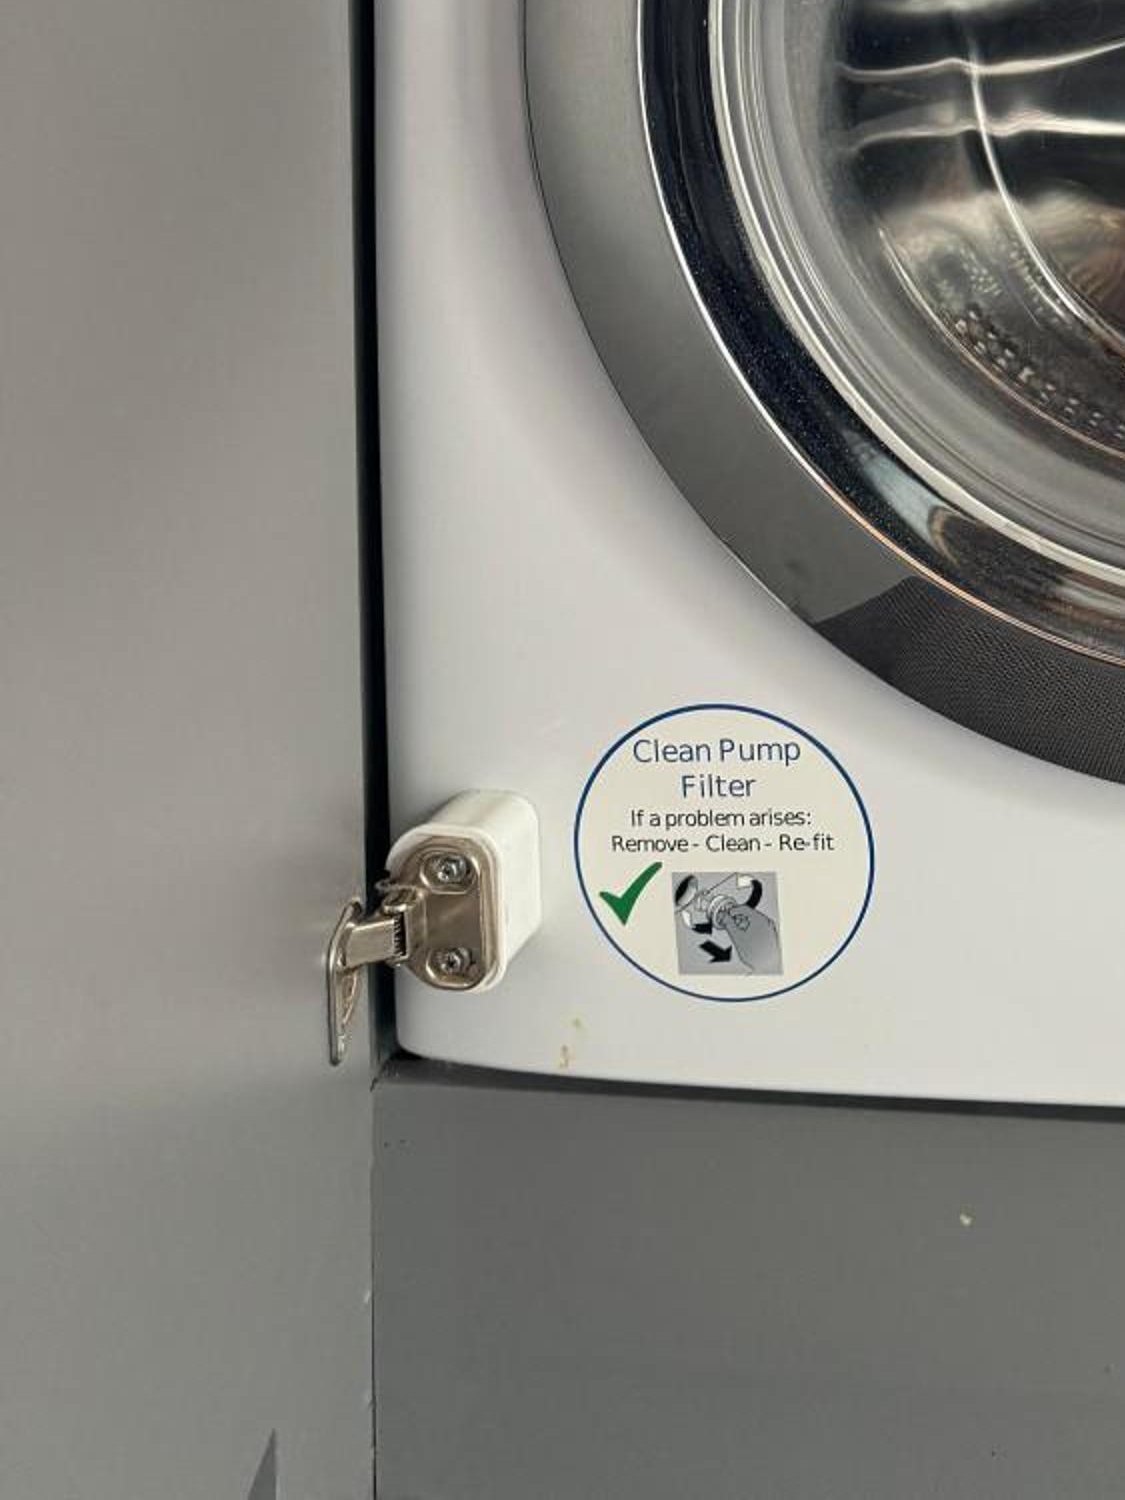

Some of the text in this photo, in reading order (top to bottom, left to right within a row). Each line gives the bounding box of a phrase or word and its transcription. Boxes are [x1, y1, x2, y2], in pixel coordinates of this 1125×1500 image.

[633, 738, 801, 767] Clean Pump
[681, 774, 757, 798] Filter
[630, 808, 812, 831] If a problem arises:
[611, 835, 689, 853] Remove
[705, 834, 760, 852] Clean
[778, 833, 835, 852] Re-fit
